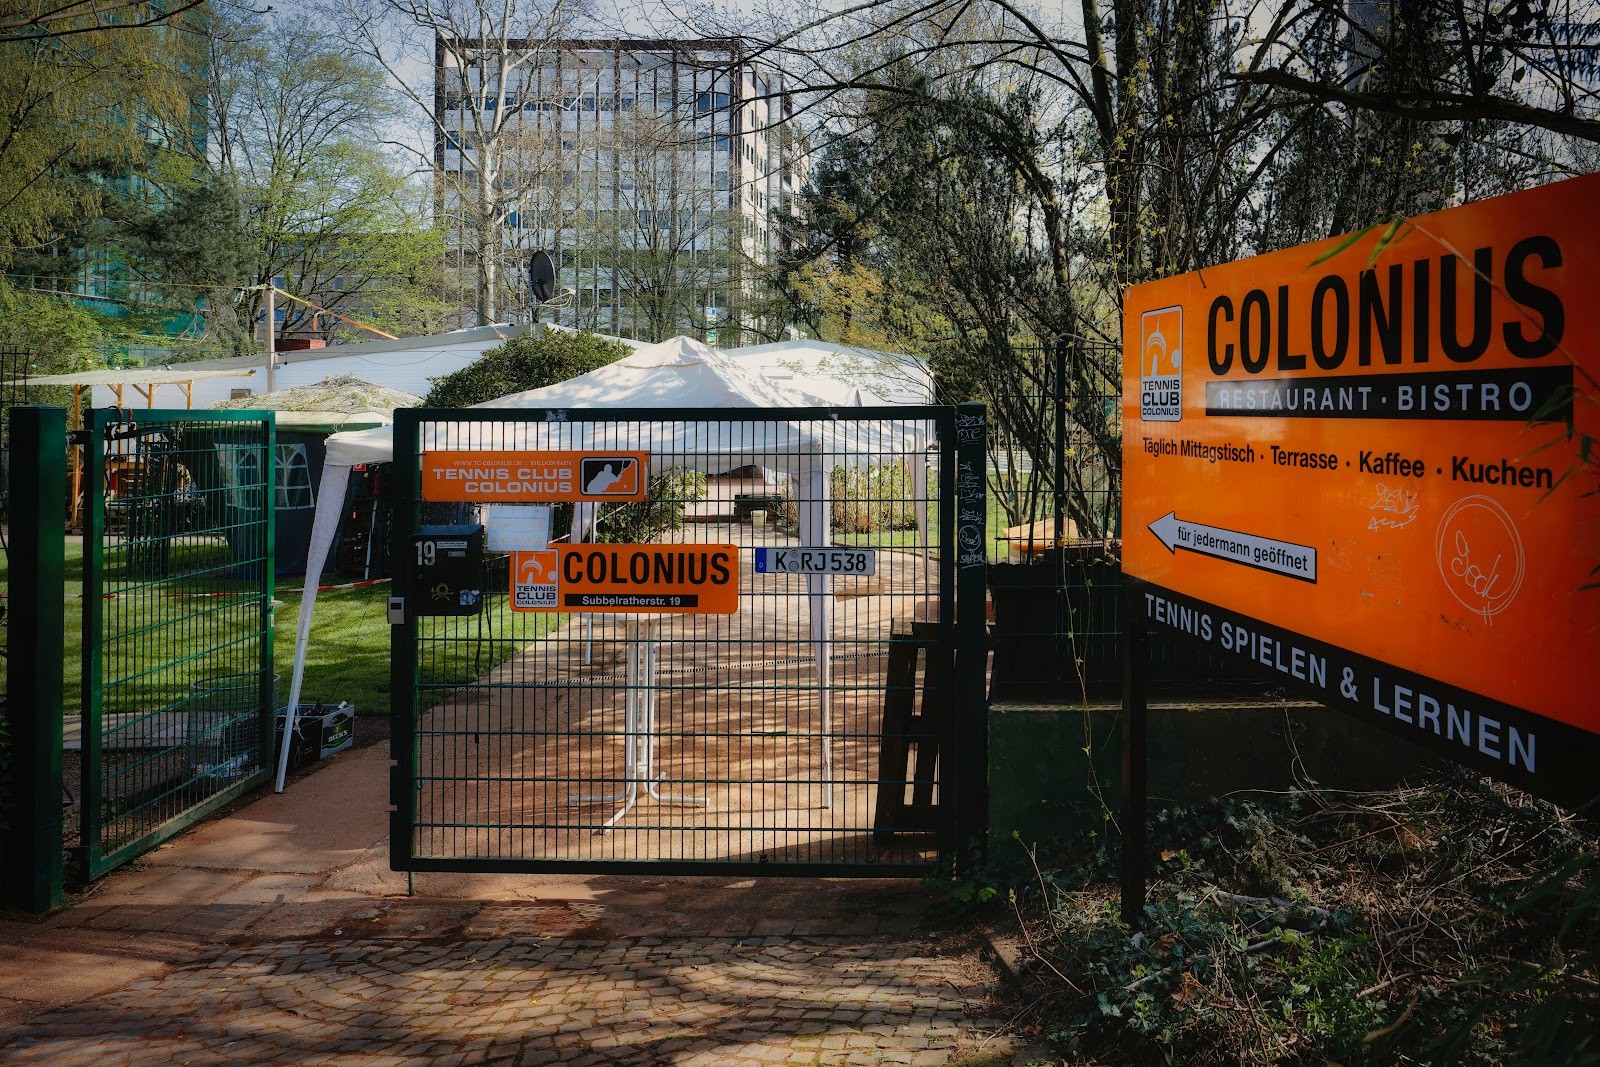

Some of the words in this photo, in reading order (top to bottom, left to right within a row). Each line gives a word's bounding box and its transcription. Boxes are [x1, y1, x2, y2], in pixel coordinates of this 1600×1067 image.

[1207, 236, 1565, 376] COLONIUS
[1143, 380, 1180, 391] TENNIS
[1142, 392, 1180, 406] CLUB
[1220, 387, 1372, 411] RESTAURANT
[1398, 381, 1533, 412] BISTRO
[1142, 407, 1180, 416] COLONIUS
[1143, 436, 1177, 457] Täglich
[1180, 439, 1254, 463] Mittagstisch
[1271, 445, 1338, 470] Terrasse
[1359, 450, 1425, 478] Kaffee
[1452, 456, 1553, 488] Kuchen
[433, 468, 510, 480] TENNIS
[517, 468, 573, 480] CLUB
[464, 481, 573, 493] COLONIUS
[415, 541, 436, 566] 19
[1178, 526, 1191, 542] für
[1193, 530, 1250, 557] jedermann
[1253, 547, 1308, 571] geöffnet
[563, 551, 730, 584] COLONIUS
[775, 551, 787, 571] K
[516, 592, 556, 600] CLUB
[582, 595, 666, 606] Subbelratherstr.
[669, 597, 681, 606] 19
[1144, 593, 1213, 642] TENNIS
[1221, 621, 1327, 689] SPIELEN
[1340, 666, 1359, 702] &
[1373, 677, 1536, 774] LERNEN
